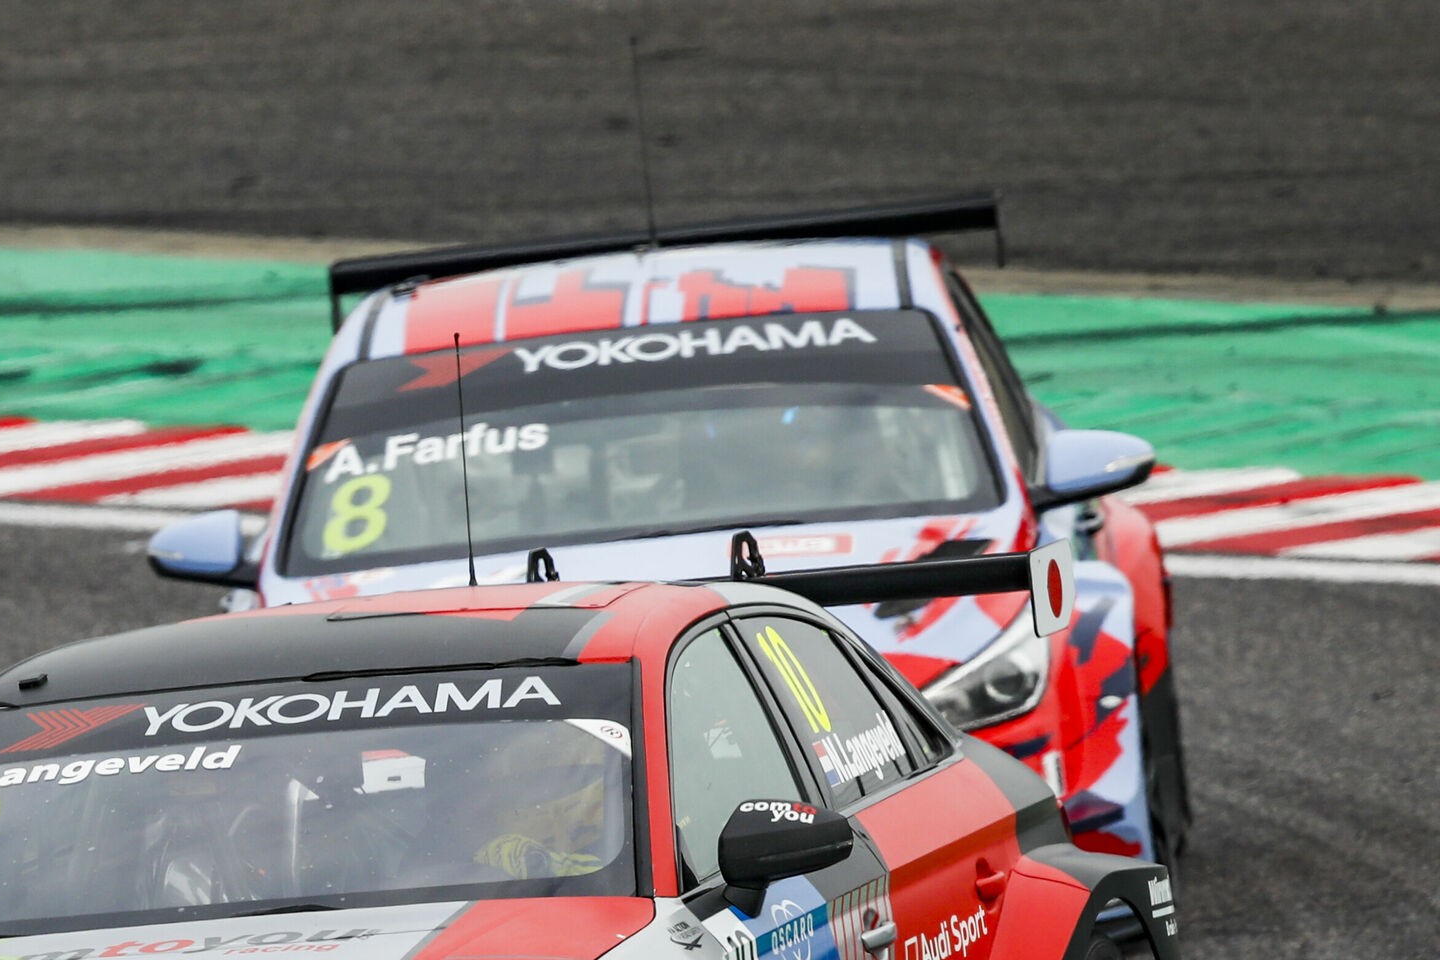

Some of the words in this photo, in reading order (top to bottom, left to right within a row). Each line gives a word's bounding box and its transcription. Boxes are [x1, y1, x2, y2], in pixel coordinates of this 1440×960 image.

[513, 318, 876, 374] YOKOHAMA
[323, 474, 391, 553] 8
[143, 676, 562, 737] YOKOHAMA
[756, 625, 832, 734] 10
[771, 809, 815, 824] you
[223, 942, 341, 956] racing
[771, 912, 815, 956] OSCARO
[951, 904, 989, 957] Sport
